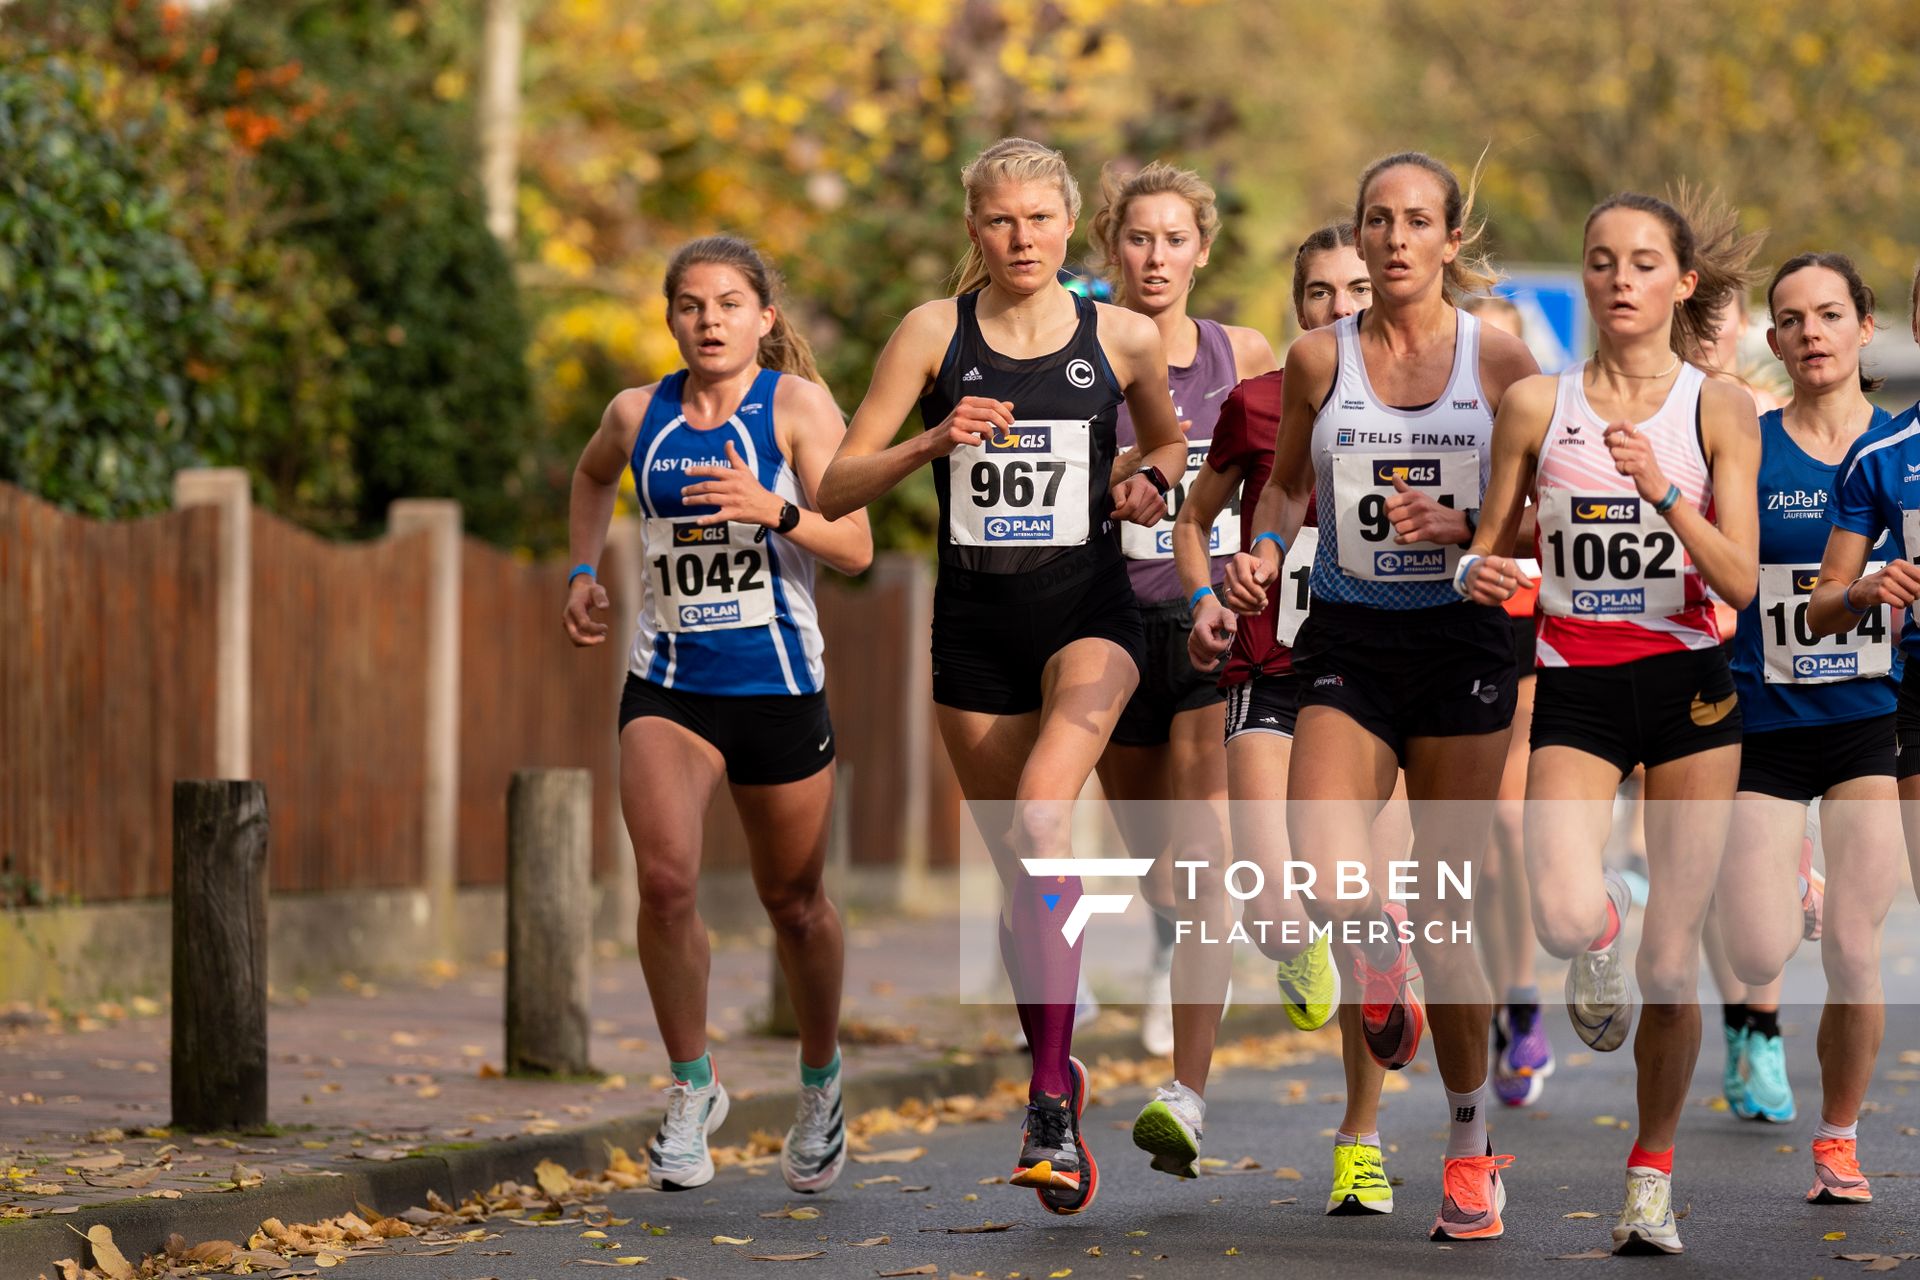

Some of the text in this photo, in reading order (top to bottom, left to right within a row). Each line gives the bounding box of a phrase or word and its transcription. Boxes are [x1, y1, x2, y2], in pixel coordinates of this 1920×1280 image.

[1020, 434, 1046, 449] GLS
[1358, 432, 1476, 446] TELIS FINANZ
[651, 458, 679, 472] ASV
[1408, 466, 1435, 481] GLS
[970, 461, 1066, 508] 967
[1607, 503, 1635, 520] GLS
[1013, 520, 1051, 531] PLAN
[703, 527, 725, 541] GLS
[1403, 553, 1443, 567] PLAN
[1548, 530, 1676, 581] 1062
[653, 549, 765, 597] 1042
[1602, 592, 1643, 606] PLAN
[702, 604, 738, 617] PLAN
[1819, 657, 1856, 669] PLAN
